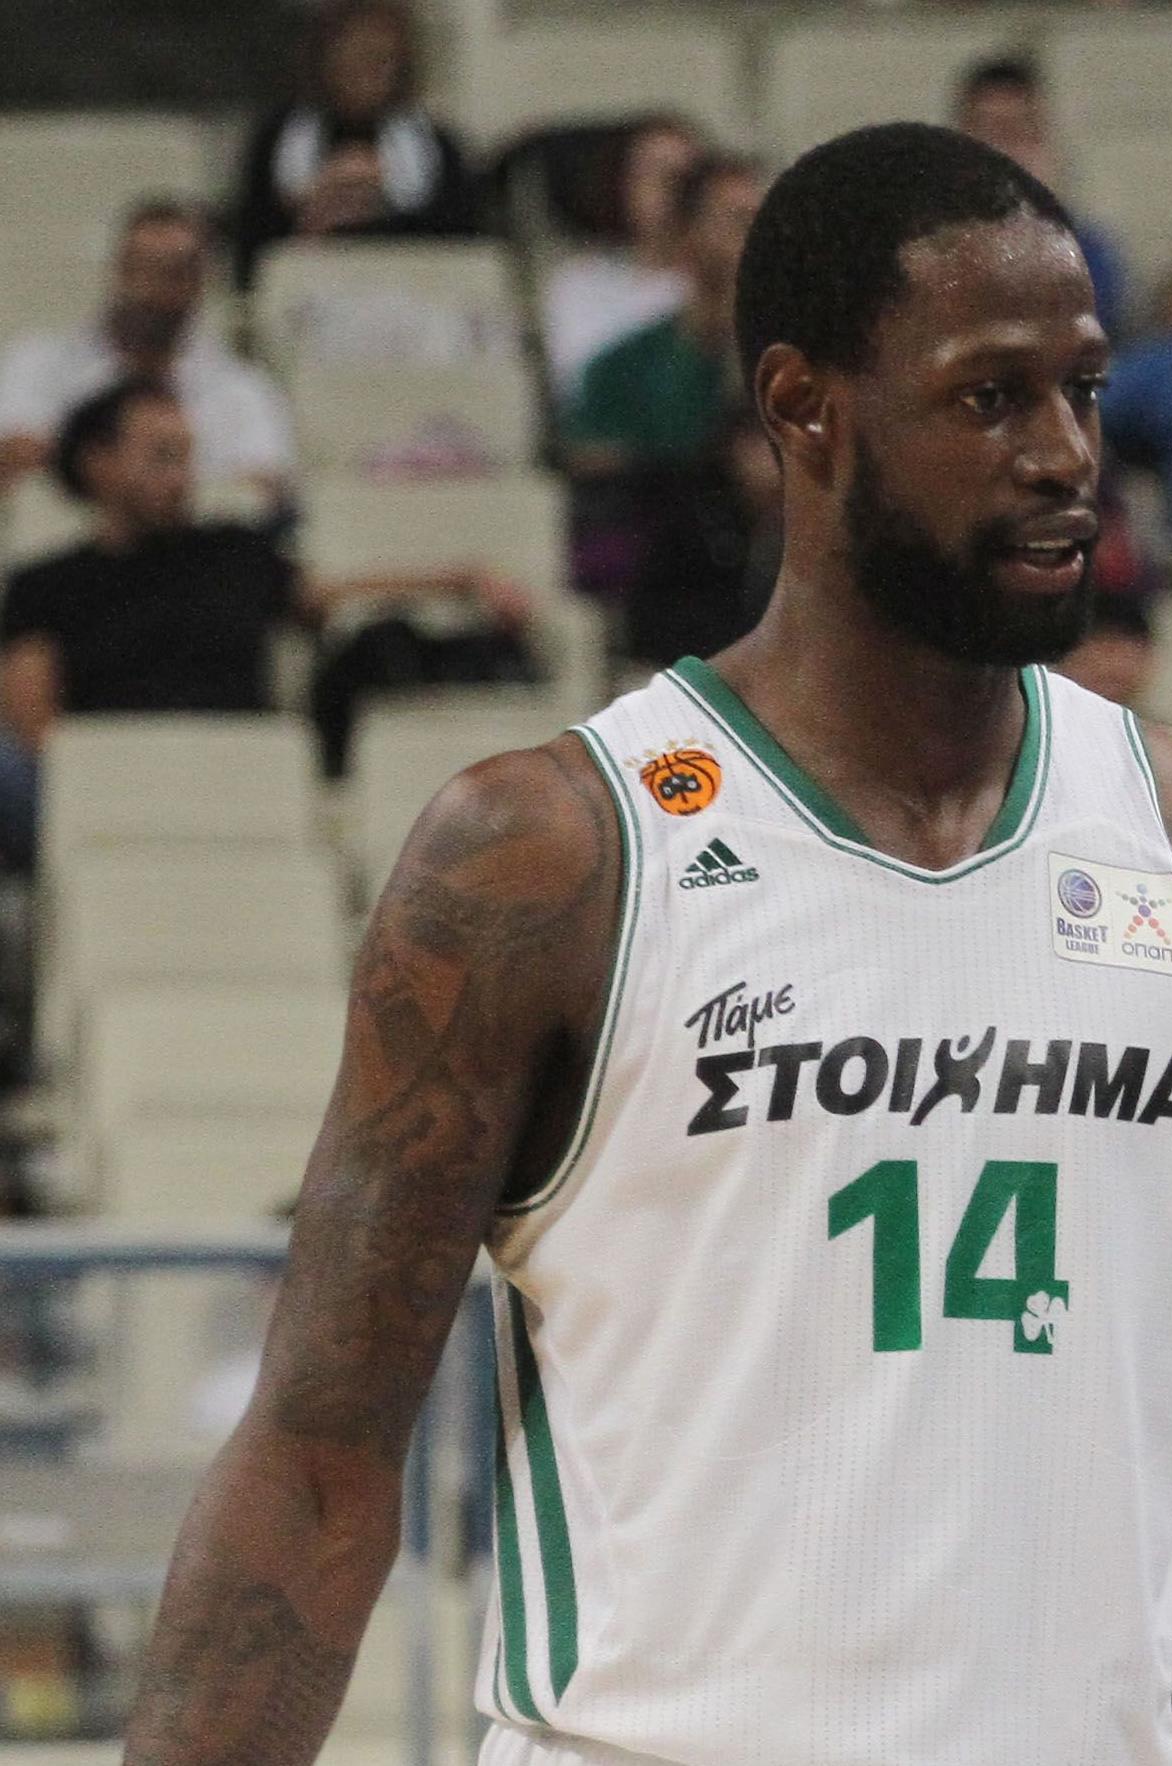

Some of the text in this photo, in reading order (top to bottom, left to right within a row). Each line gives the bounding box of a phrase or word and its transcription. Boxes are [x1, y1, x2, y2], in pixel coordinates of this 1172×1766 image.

[679, 866, 760, 890] adidas
[1056, 917, 1108, 943] BASKET
[827, 1160, 1069, 1355] 14
